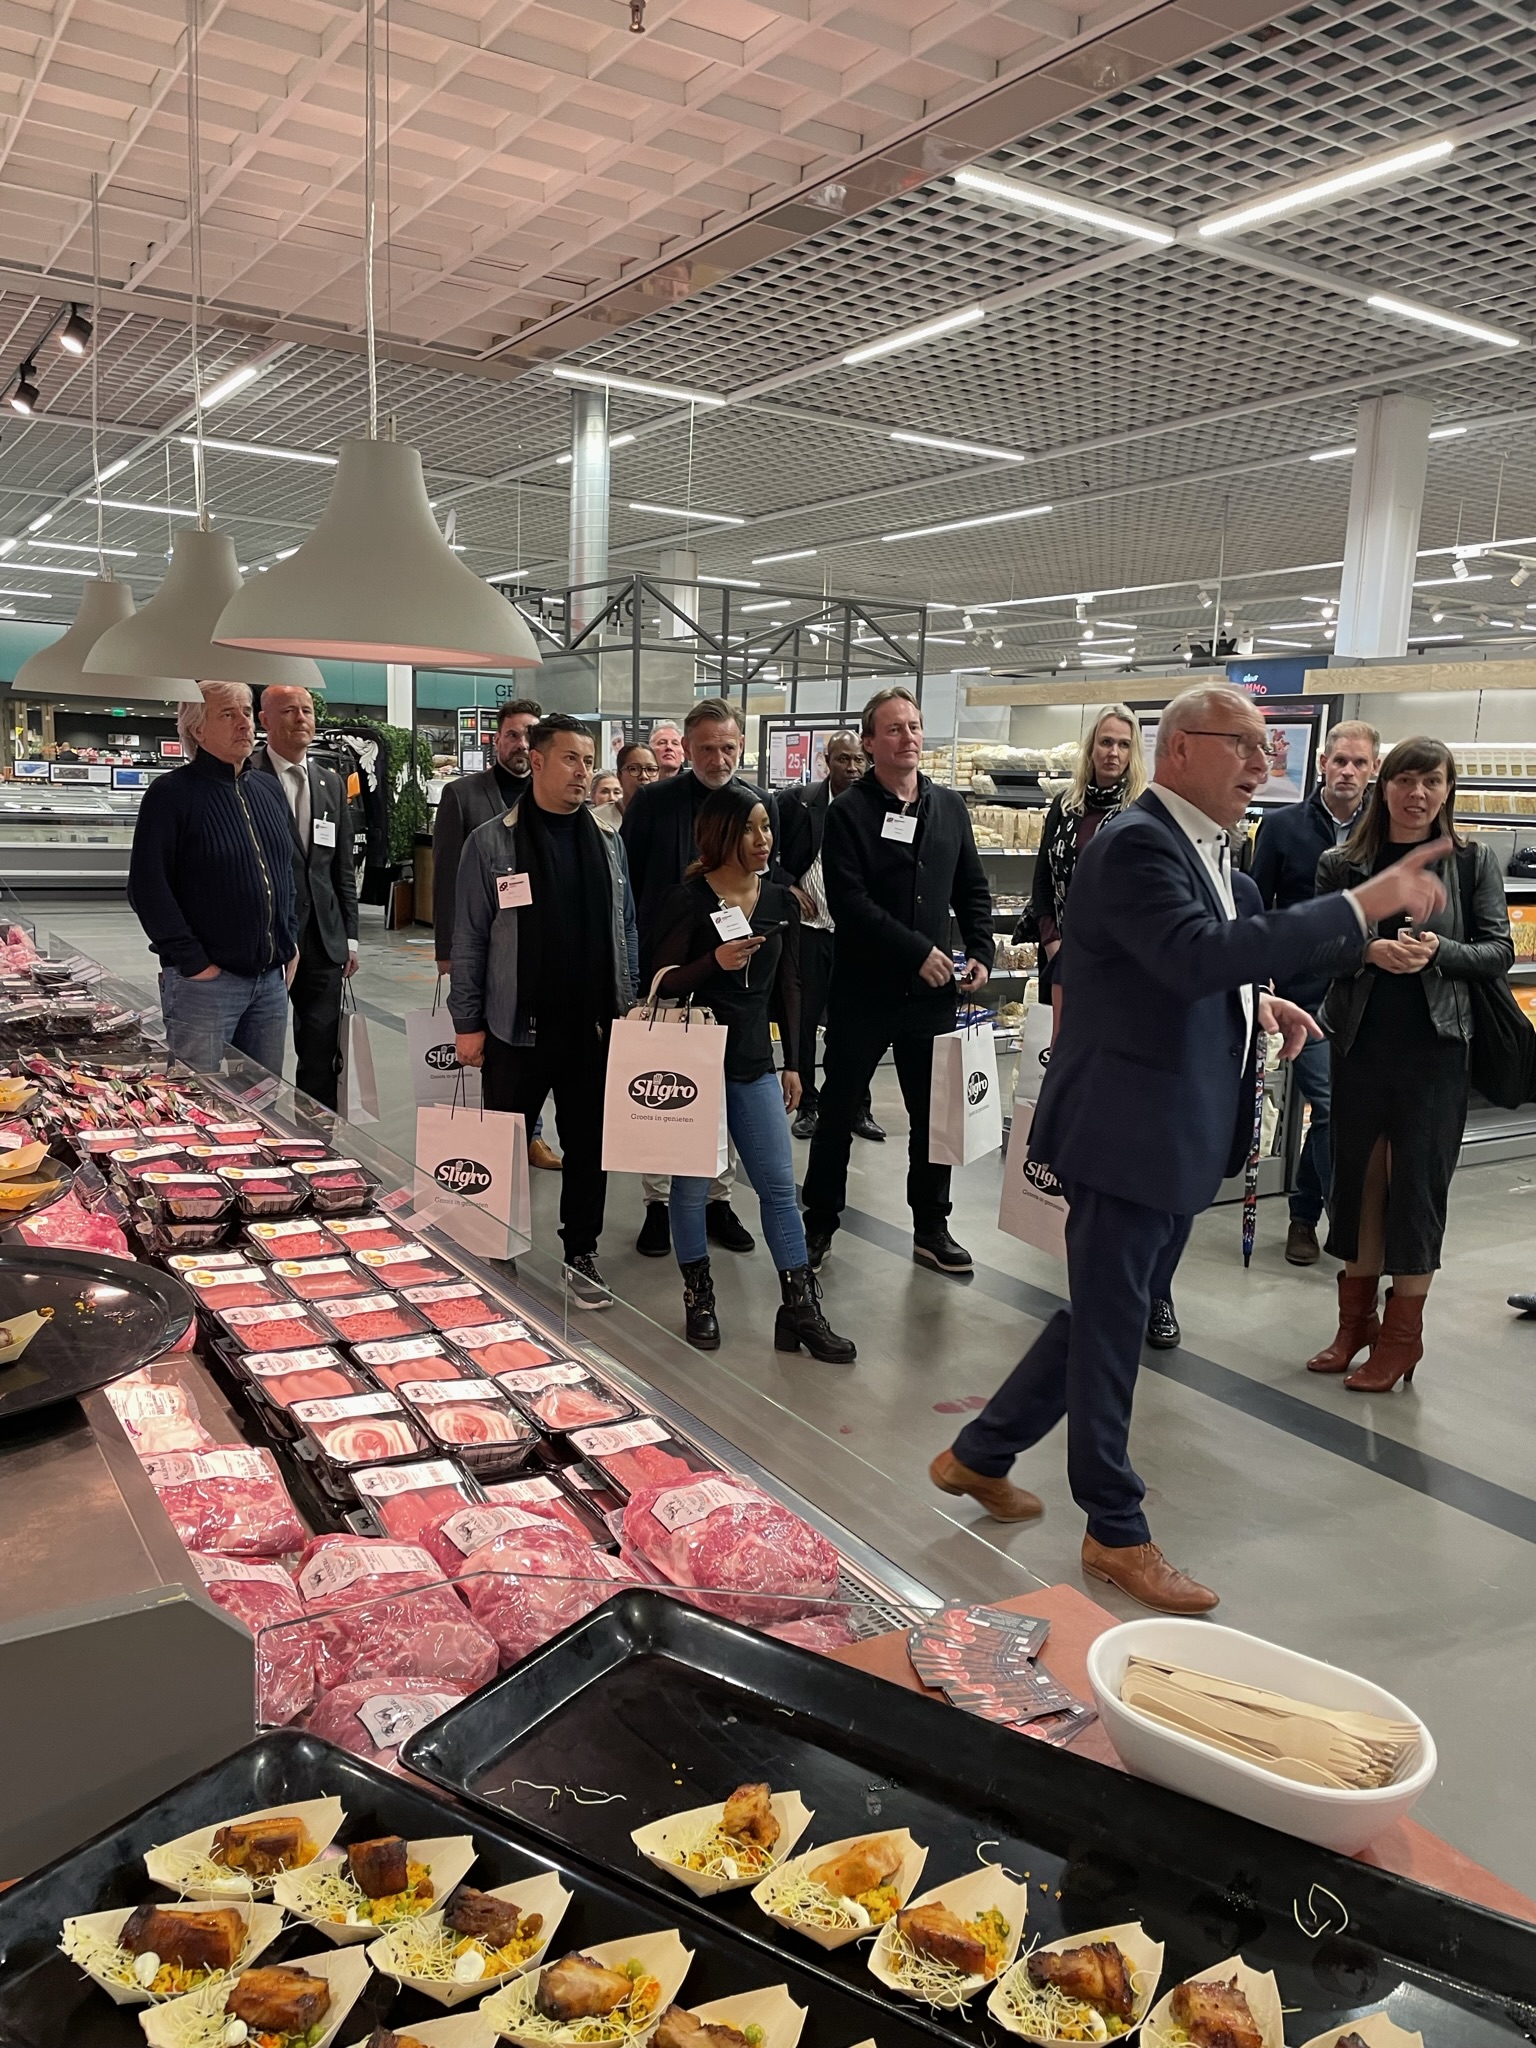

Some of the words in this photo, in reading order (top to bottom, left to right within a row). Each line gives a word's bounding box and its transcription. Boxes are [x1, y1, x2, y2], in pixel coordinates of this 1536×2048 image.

[427, 1050, 457, 1066] Slig
[631, 1077, 695, 1102] Sligro
[631, 1113, 653, 1121] Groots
[663, 1115, 694, 1123] genieten
[436, 1164, 490, 1188] Sligro
[1025, 1161, 1063, 1188] Sligr
